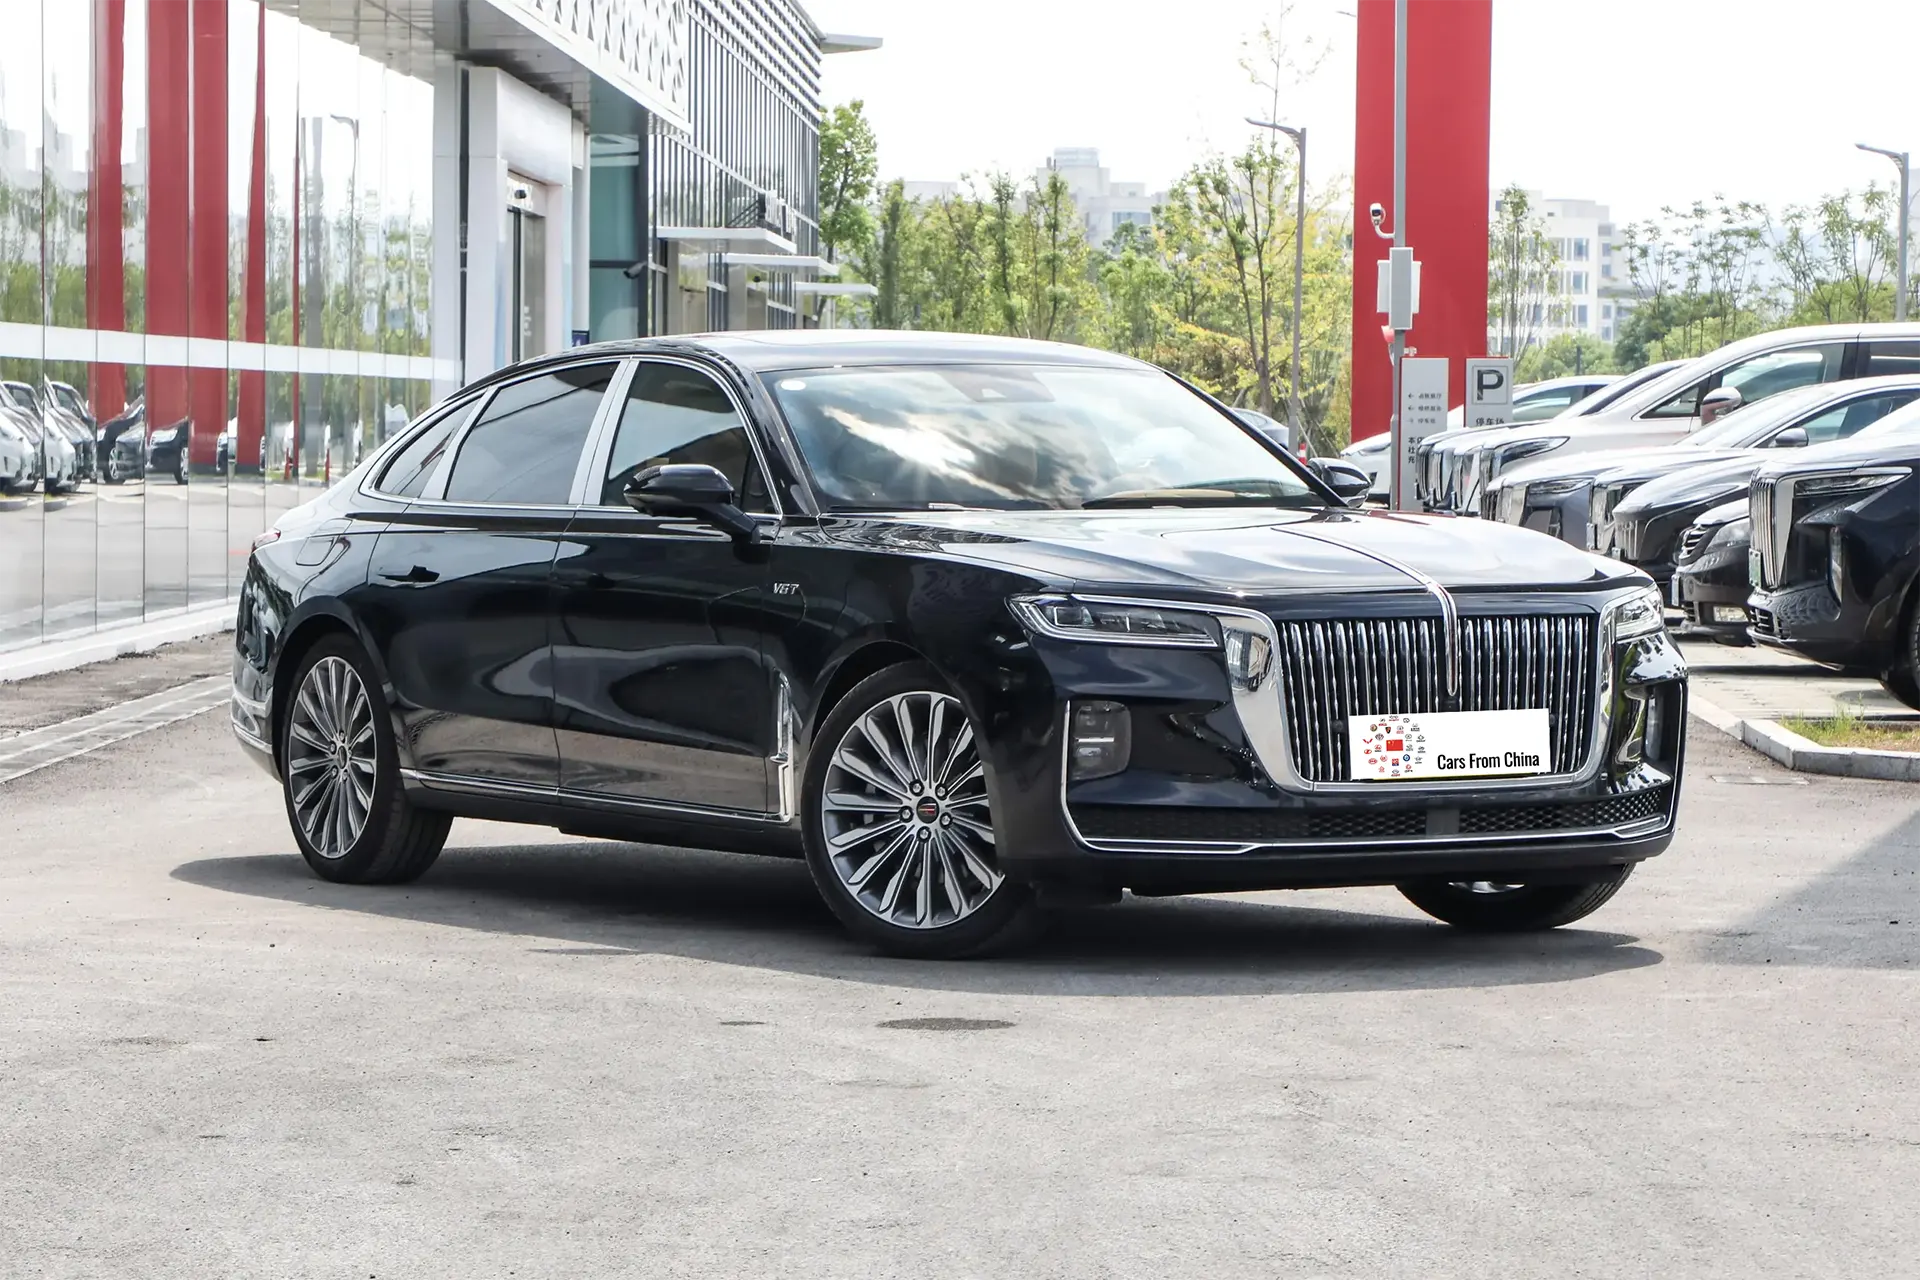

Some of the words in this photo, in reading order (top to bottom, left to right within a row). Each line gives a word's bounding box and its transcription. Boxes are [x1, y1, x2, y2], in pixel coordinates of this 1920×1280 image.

[1477, 369, 1504, 401] P
[1476, 417, 1505, 426] 停车场
